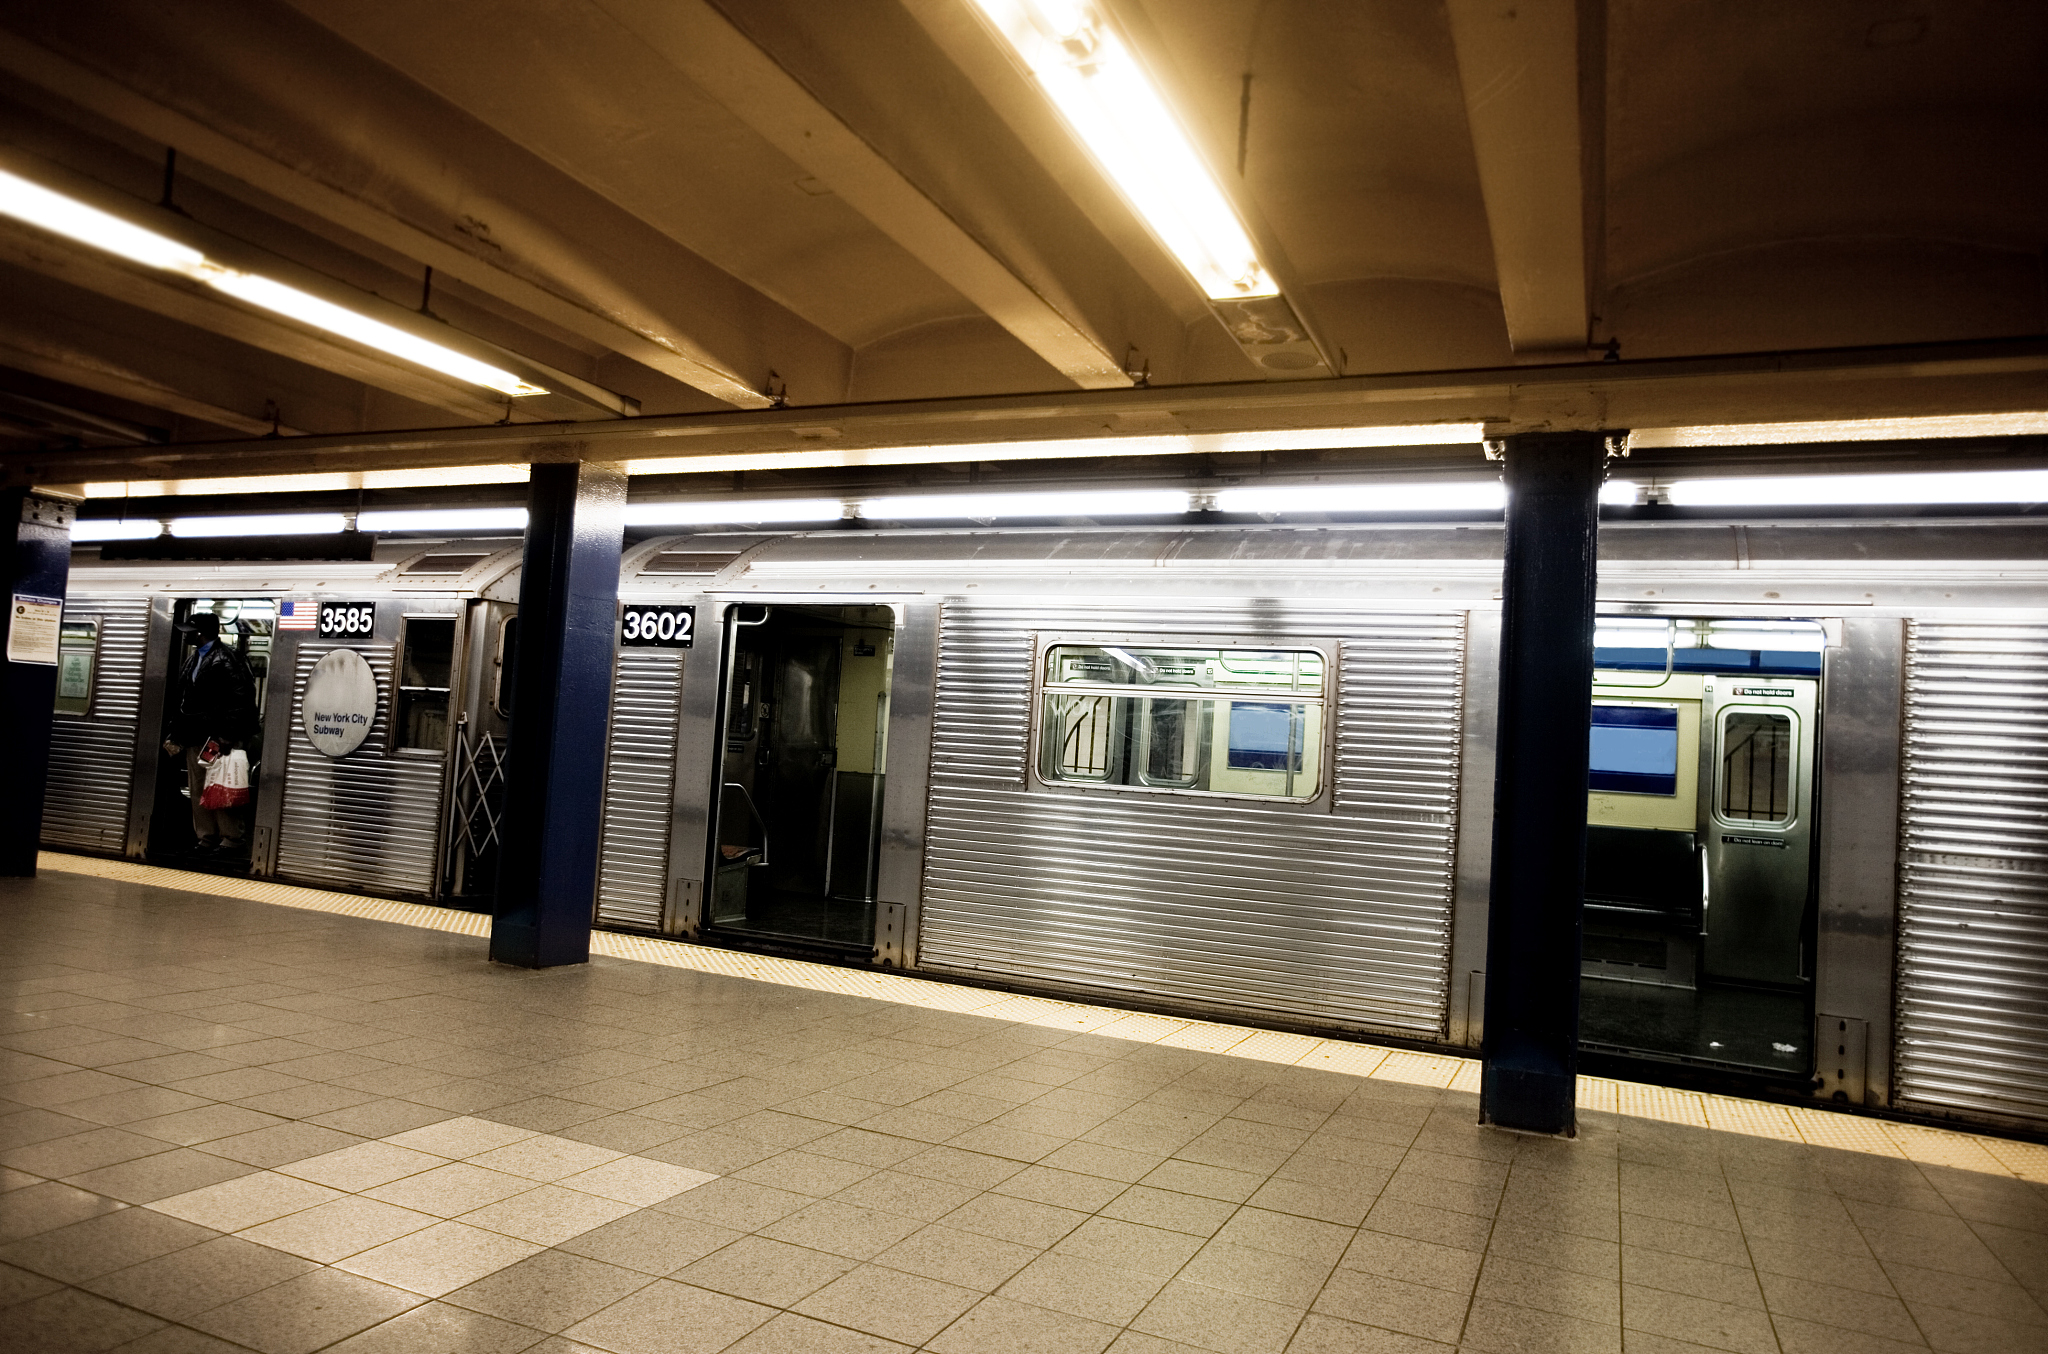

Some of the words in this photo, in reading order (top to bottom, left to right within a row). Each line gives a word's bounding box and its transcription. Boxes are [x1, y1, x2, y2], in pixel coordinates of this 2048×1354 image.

[321, 607, 373, 633] 3585
[623, 611, 692, 640] 3602
[314, 712, 332, 722] New
[333, 712, 350, 723] York
[351, 713, 368, 726] City
[313, 724, 344, 738] Subway
